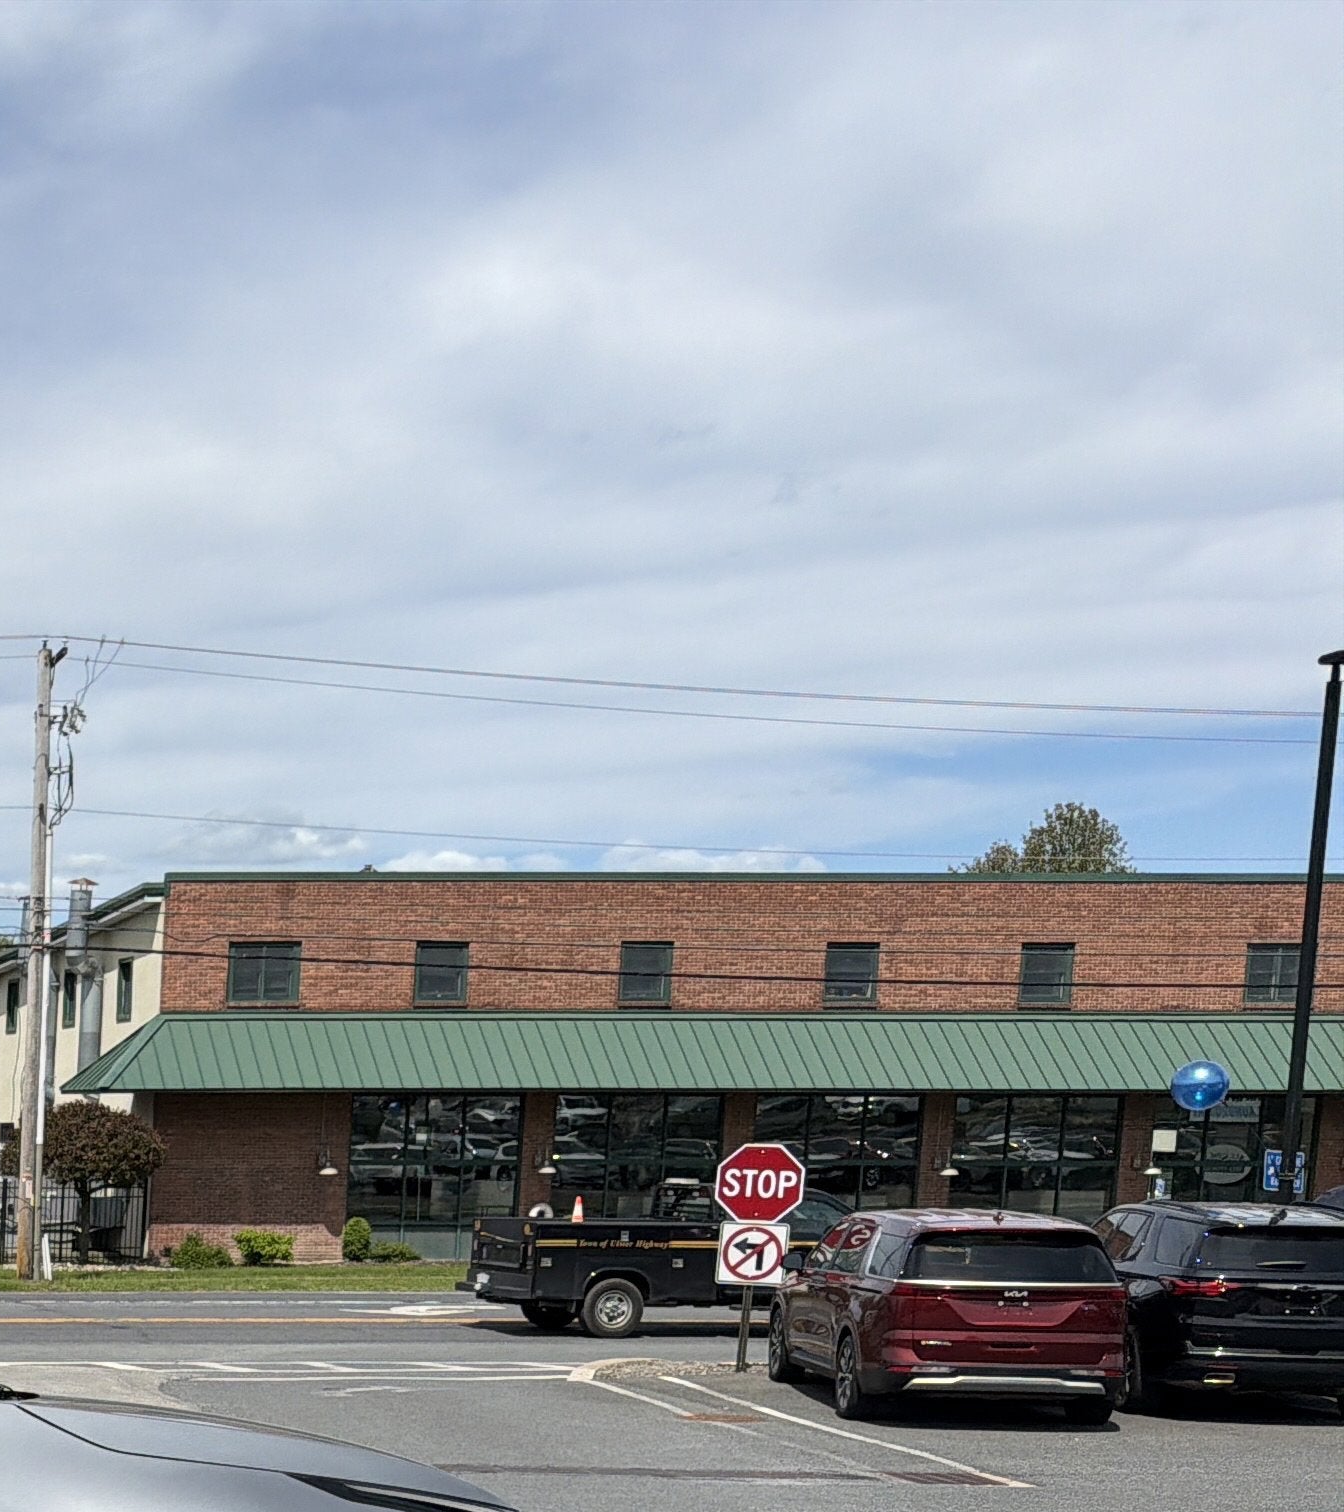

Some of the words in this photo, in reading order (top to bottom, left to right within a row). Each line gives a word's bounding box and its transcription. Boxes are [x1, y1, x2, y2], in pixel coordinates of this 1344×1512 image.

[722, 1168, 798, 1199] STOP
[578, 1239, 598, 1247] Town
[635, 1239, 669, 1250] Highway
